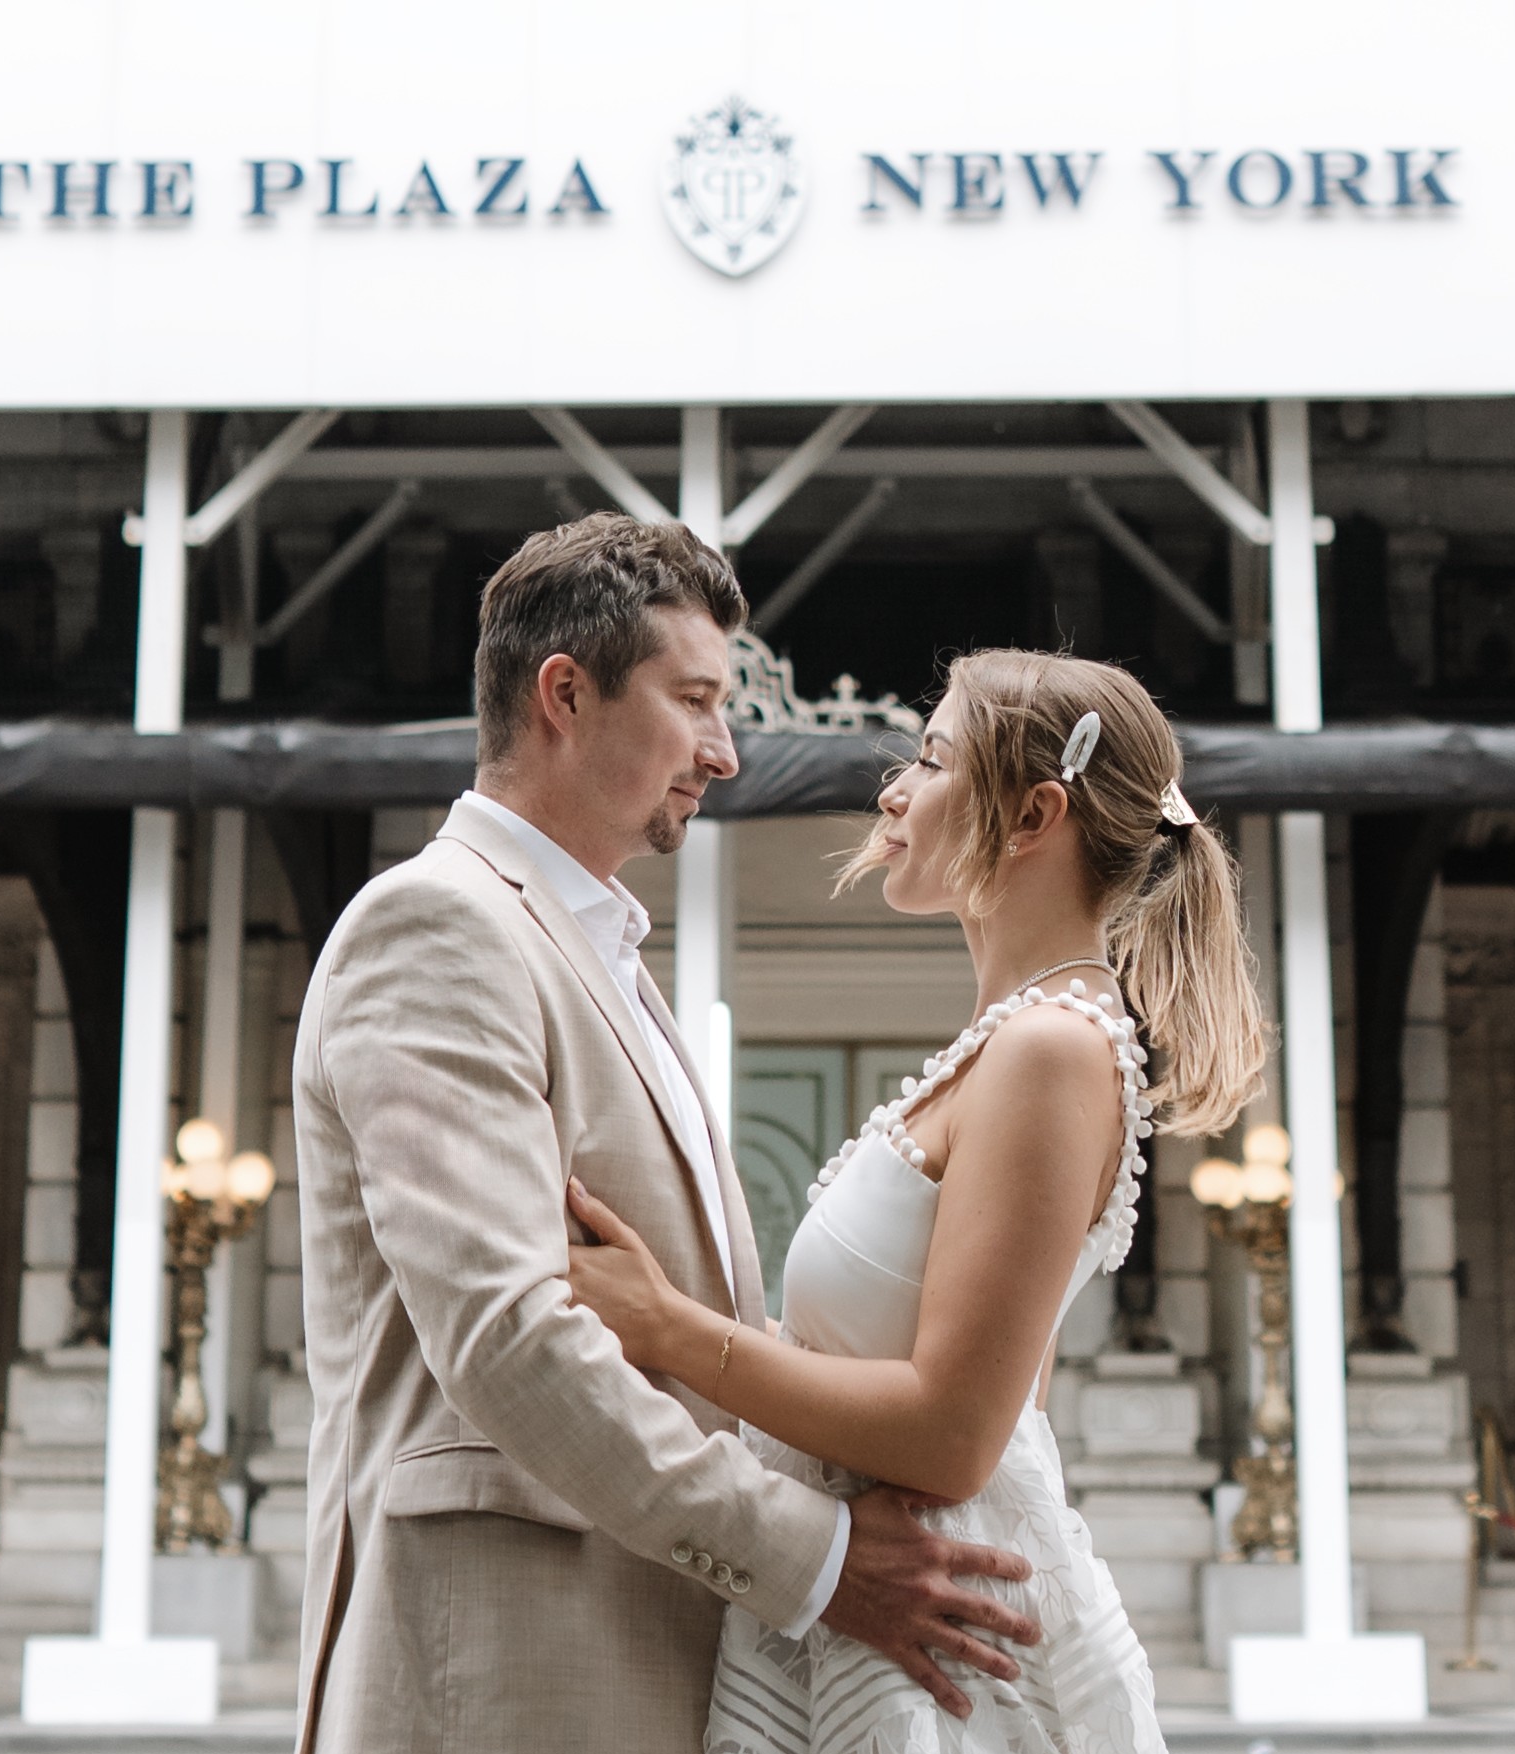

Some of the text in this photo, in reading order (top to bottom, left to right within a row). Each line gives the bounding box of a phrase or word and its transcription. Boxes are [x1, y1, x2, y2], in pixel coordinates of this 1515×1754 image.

[248, 158, 610, 216] PLAZA
[862, 149, 1457, 210] NEW YORK
